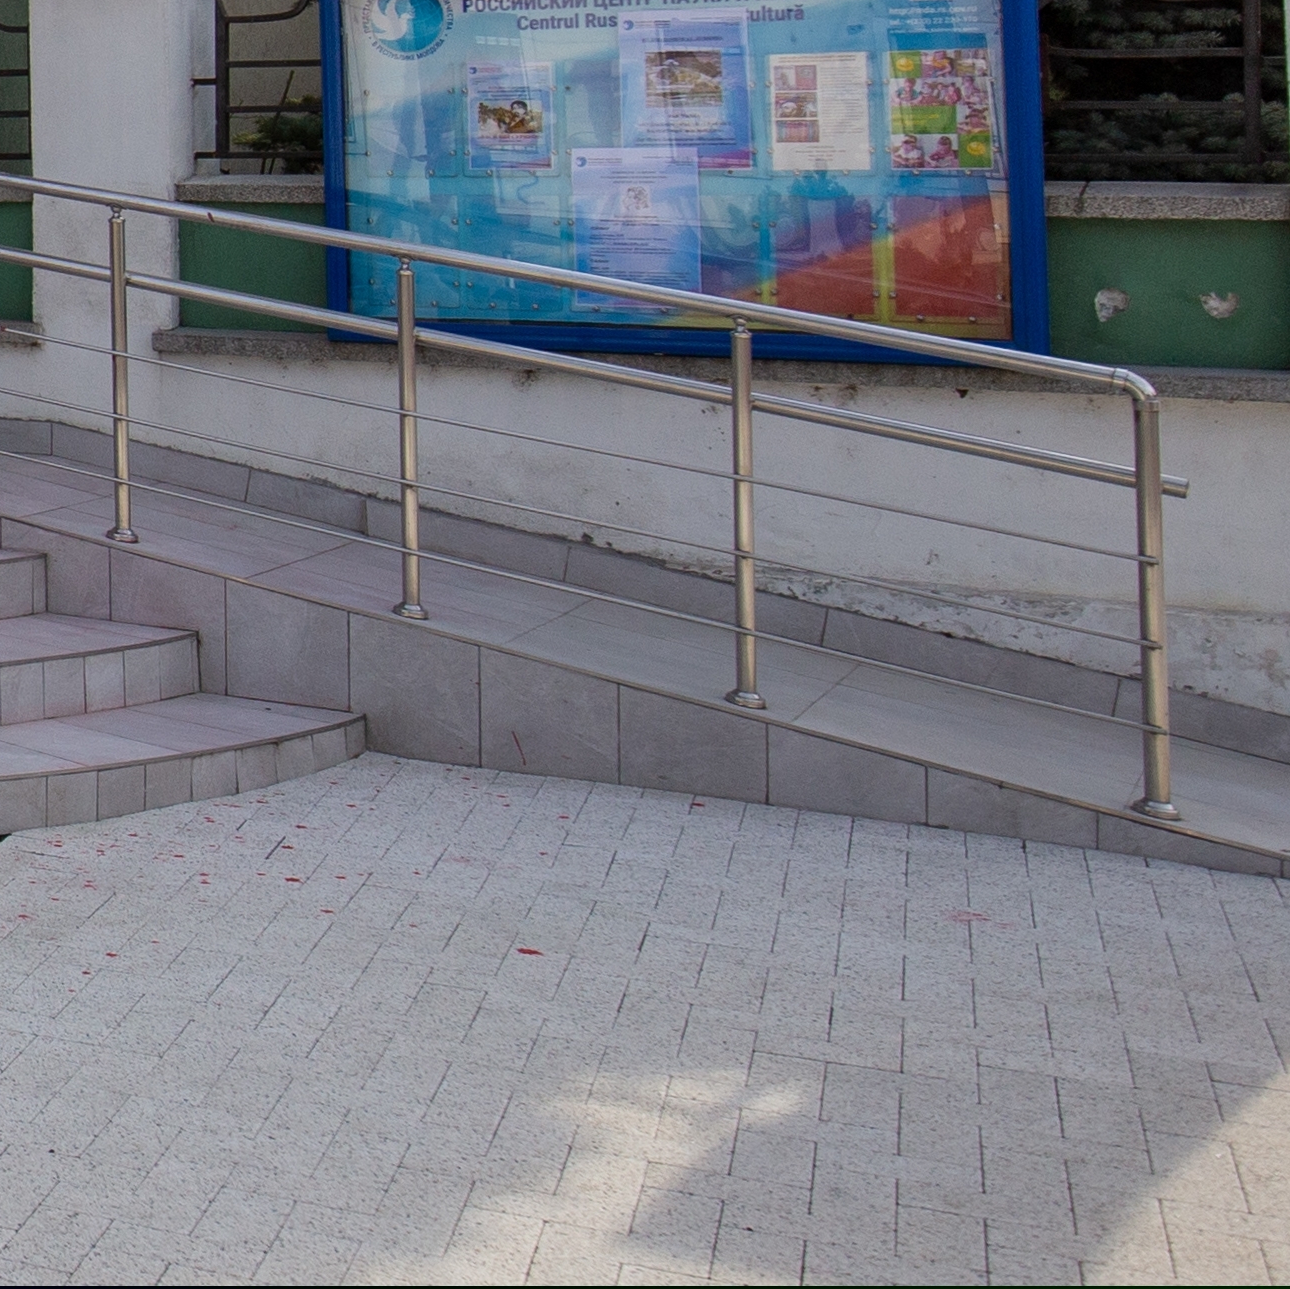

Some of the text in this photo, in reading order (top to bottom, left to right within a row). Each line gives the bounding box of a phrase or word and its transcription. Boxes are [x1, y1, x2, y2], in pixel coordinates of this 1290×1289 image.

[517, 14, 579, 30] Centrul
[585, 12, 618, 28] Rus
[746, 4, 805, 22] ultură
